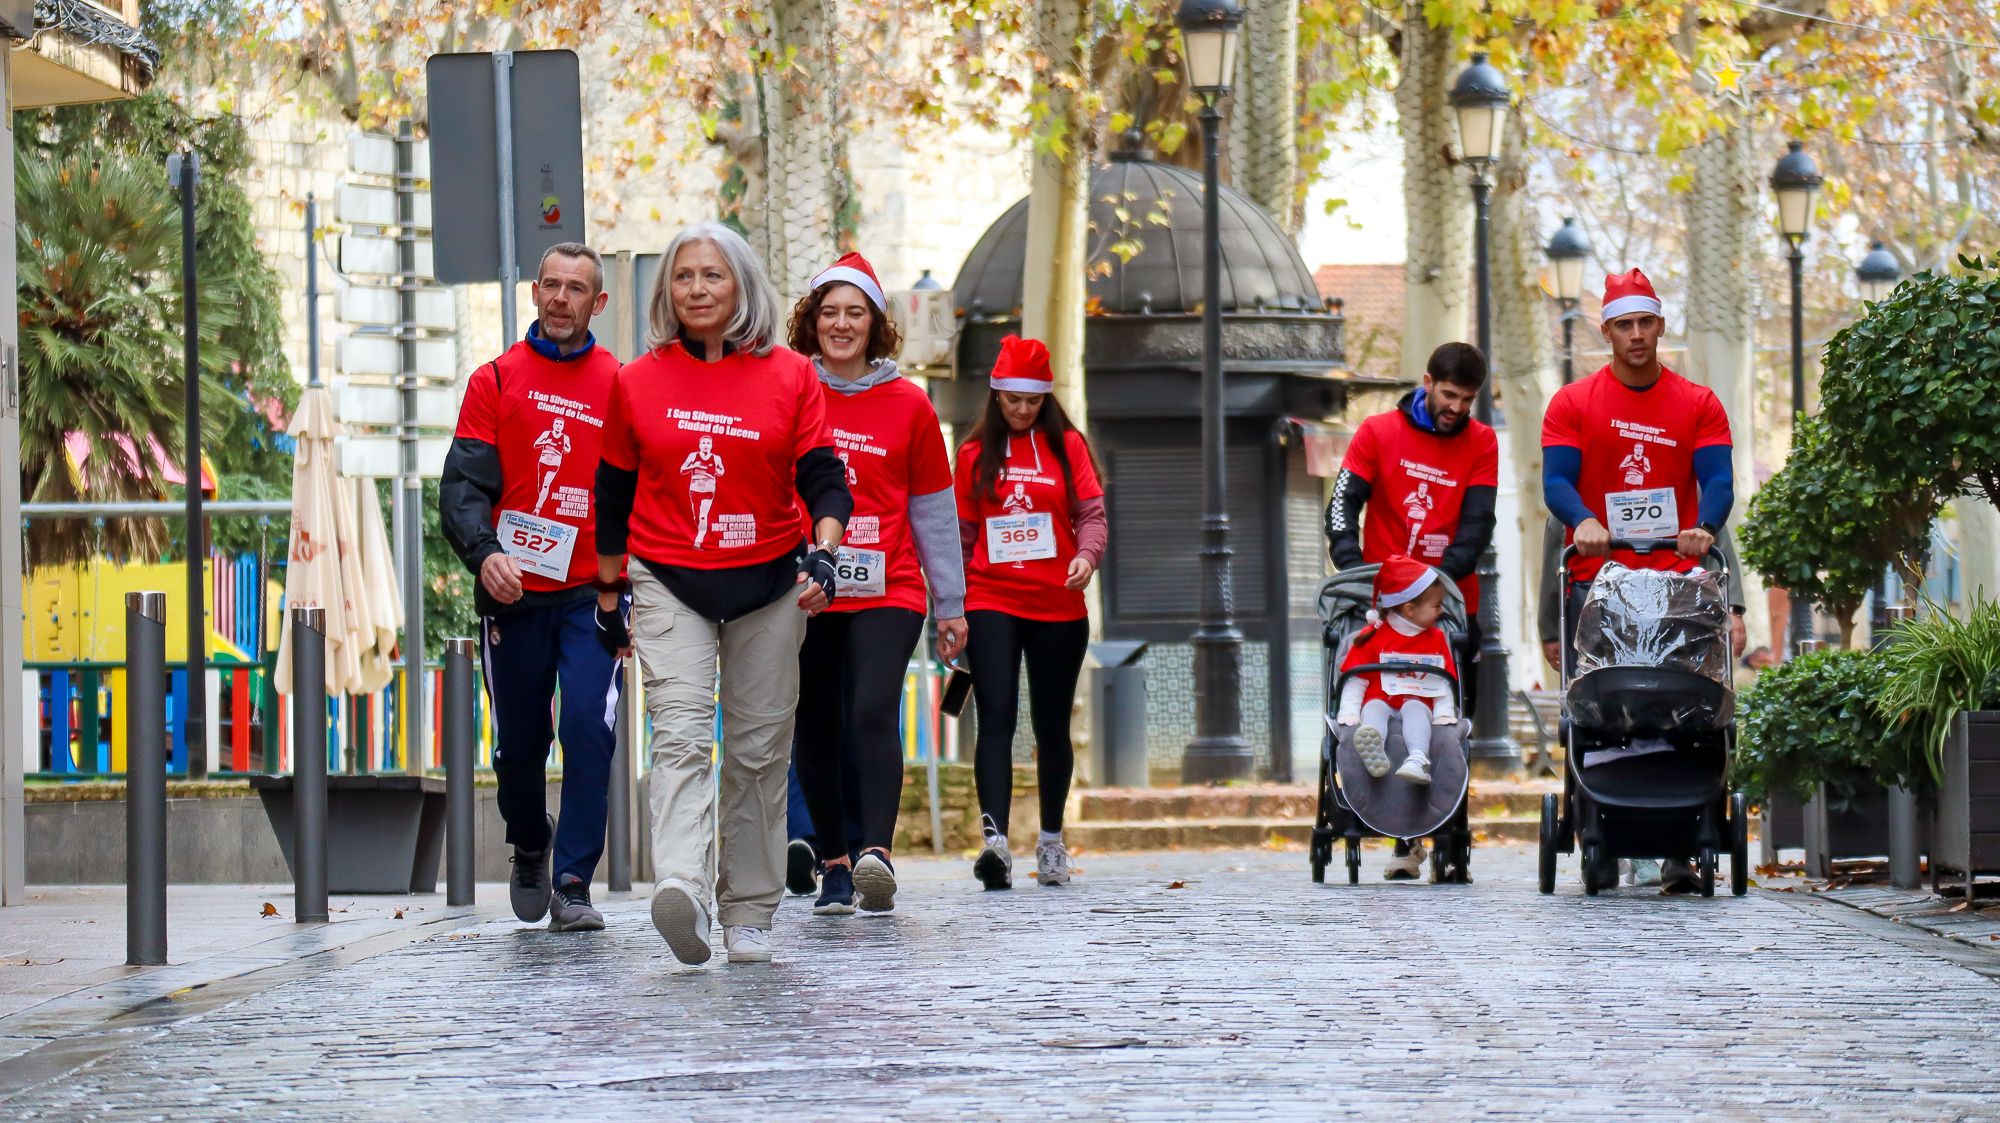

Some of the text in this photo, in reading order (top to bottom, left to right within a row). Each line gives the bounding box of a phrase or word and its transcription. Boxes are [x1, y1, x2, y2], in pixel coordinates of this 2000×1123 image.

[528, 390, 534, 399] I
[533, 391, 549, 402] San
[549, 394, 584, 411] Silvestre
[537, 401, 604, 428] Ciudad de Lucena
[666, 408, 673, 418] I
[673, 408, 692, 420] San
[692, 410, 734, 425] Silvestre
[677, 419, 760, 440] Ciudad de Lucena
[1615, 420, 1629, 430] San
[833, 428, 867, 443] Silvestre
[848, 442, 860, 451] de
[860, 443, 887, 457] Lucena
[1000, 474, 1023, 482] Cudad
[551, 492, 589, 504] JOSE CARLOS
[559, 485, 589, 497] MEMORIAL
[561, 500, 589, 511] HURTADO
[719, 514, 755, 523] MEMORIAL
[1621, 505, 1663, 522] 370
[711, 522, 756, 532] JOSE CARLOS
[511, 529, 558, 554] 527
[723, 530, 756, 540] HURTADO
[1001, 528, 1039, 544] 369
[837, 564, 869, 582] 68
